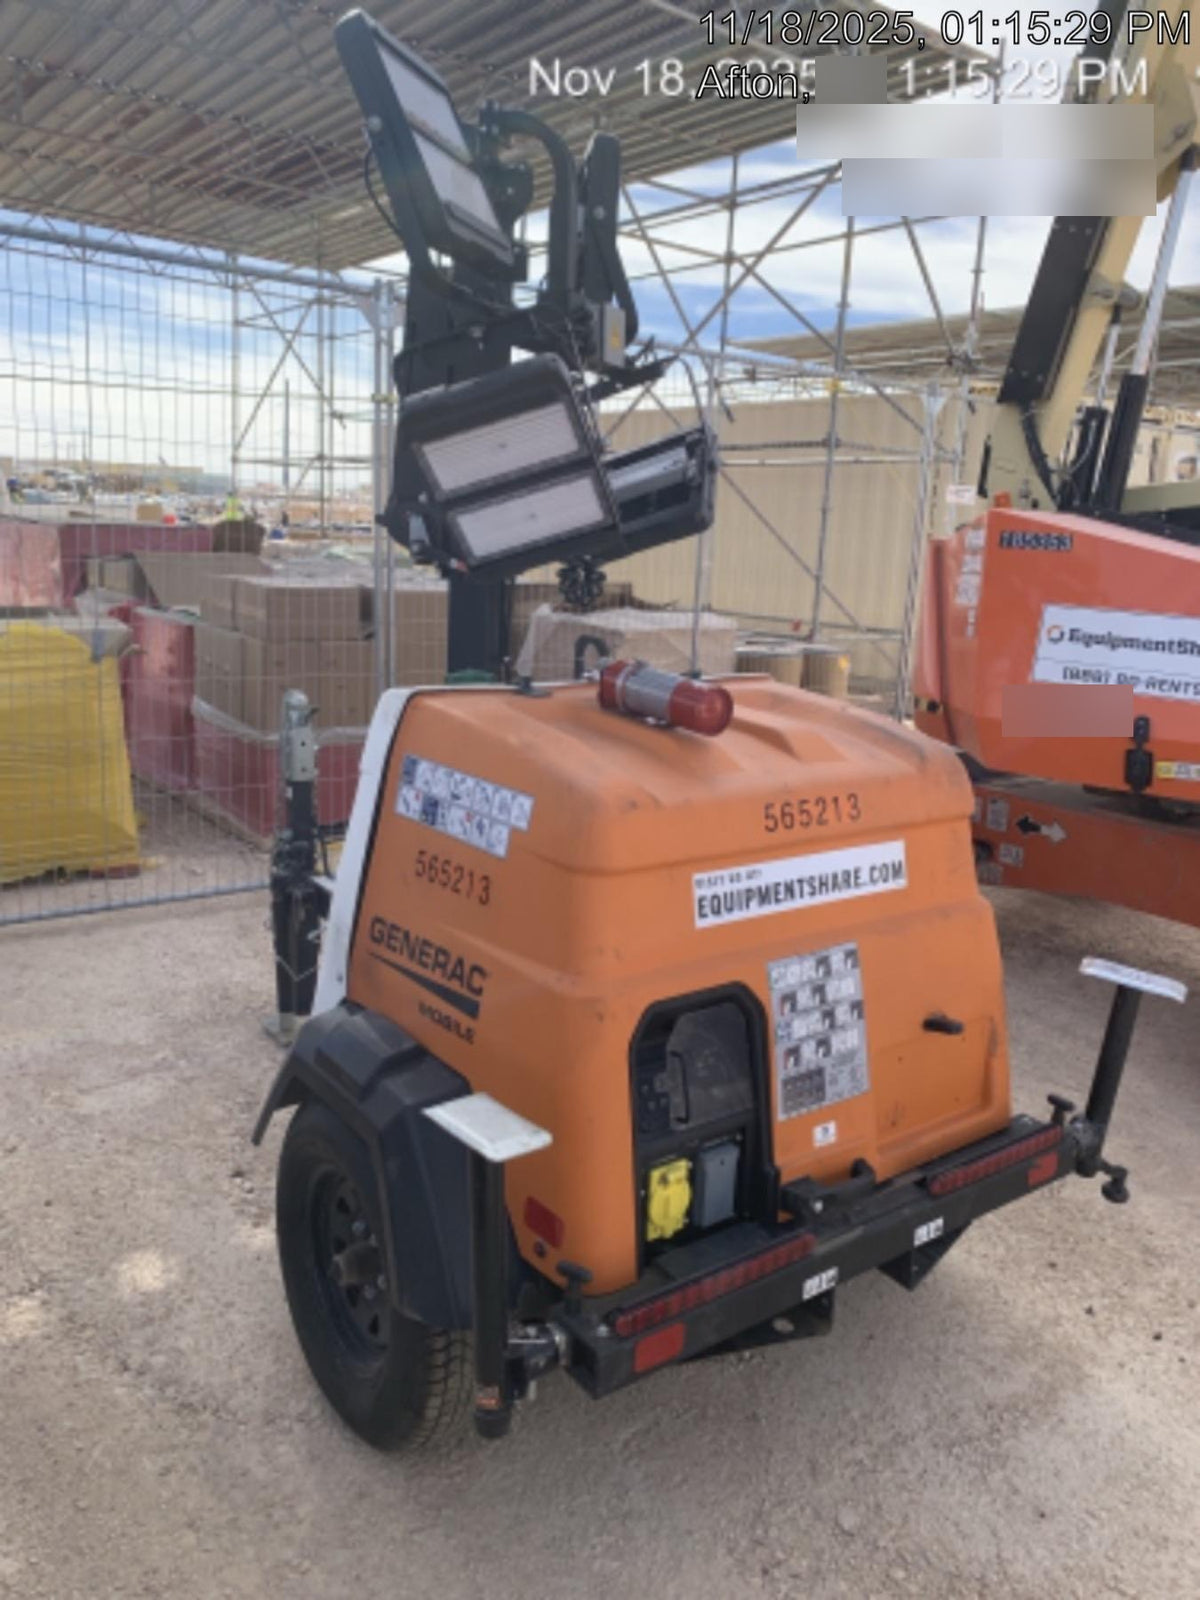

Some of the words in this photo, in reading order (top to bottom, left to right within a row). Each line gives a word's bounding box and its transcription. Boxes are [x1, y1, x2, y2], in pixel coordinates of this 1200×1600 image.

[763, 793, 862, 833] 565213
[414, 849, 492, 907] 565213
[697, 859, 904, 920] EQUIPMENTSHARE.COM
[369, 914, 487, 997] GENERAC
